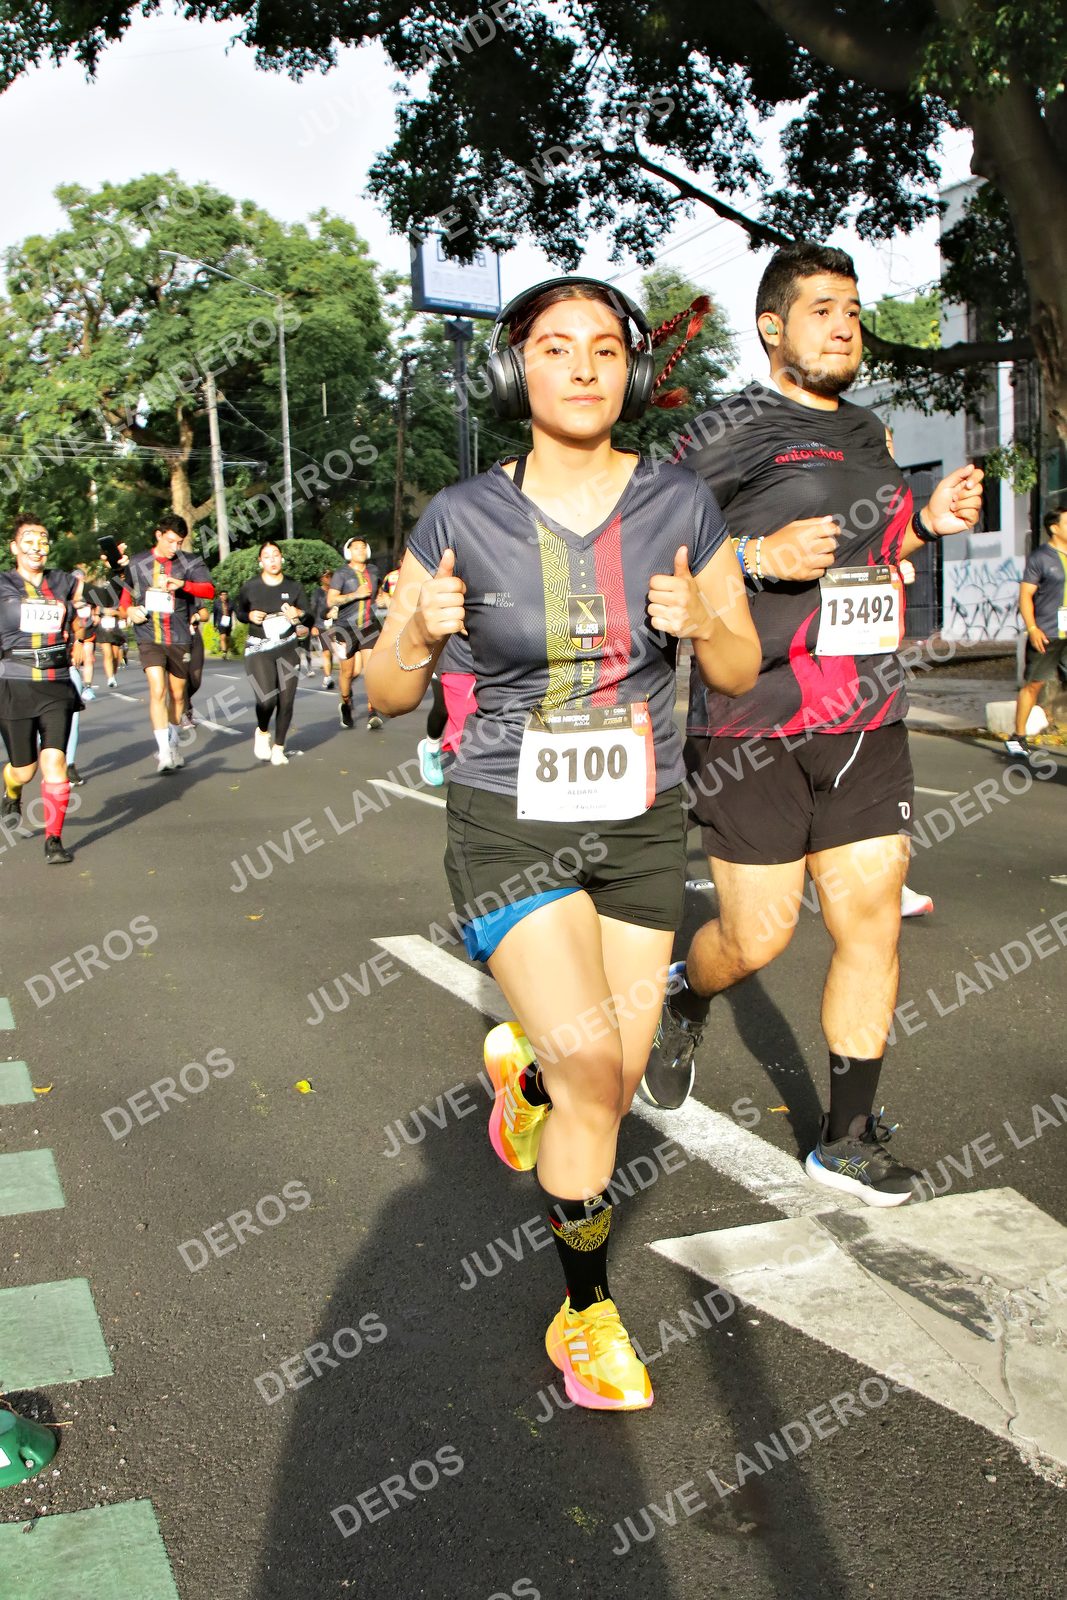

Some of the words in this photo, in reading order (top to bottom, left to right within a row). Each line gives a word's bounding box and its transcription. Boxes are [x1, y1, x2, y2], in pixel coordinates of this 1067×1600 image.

[775, 448, 845, 464] antorchas
[26, 608, 60, 621] 11254
[827, 595, 894, 626] 13492
[535, 744, 628, 783] 8100
